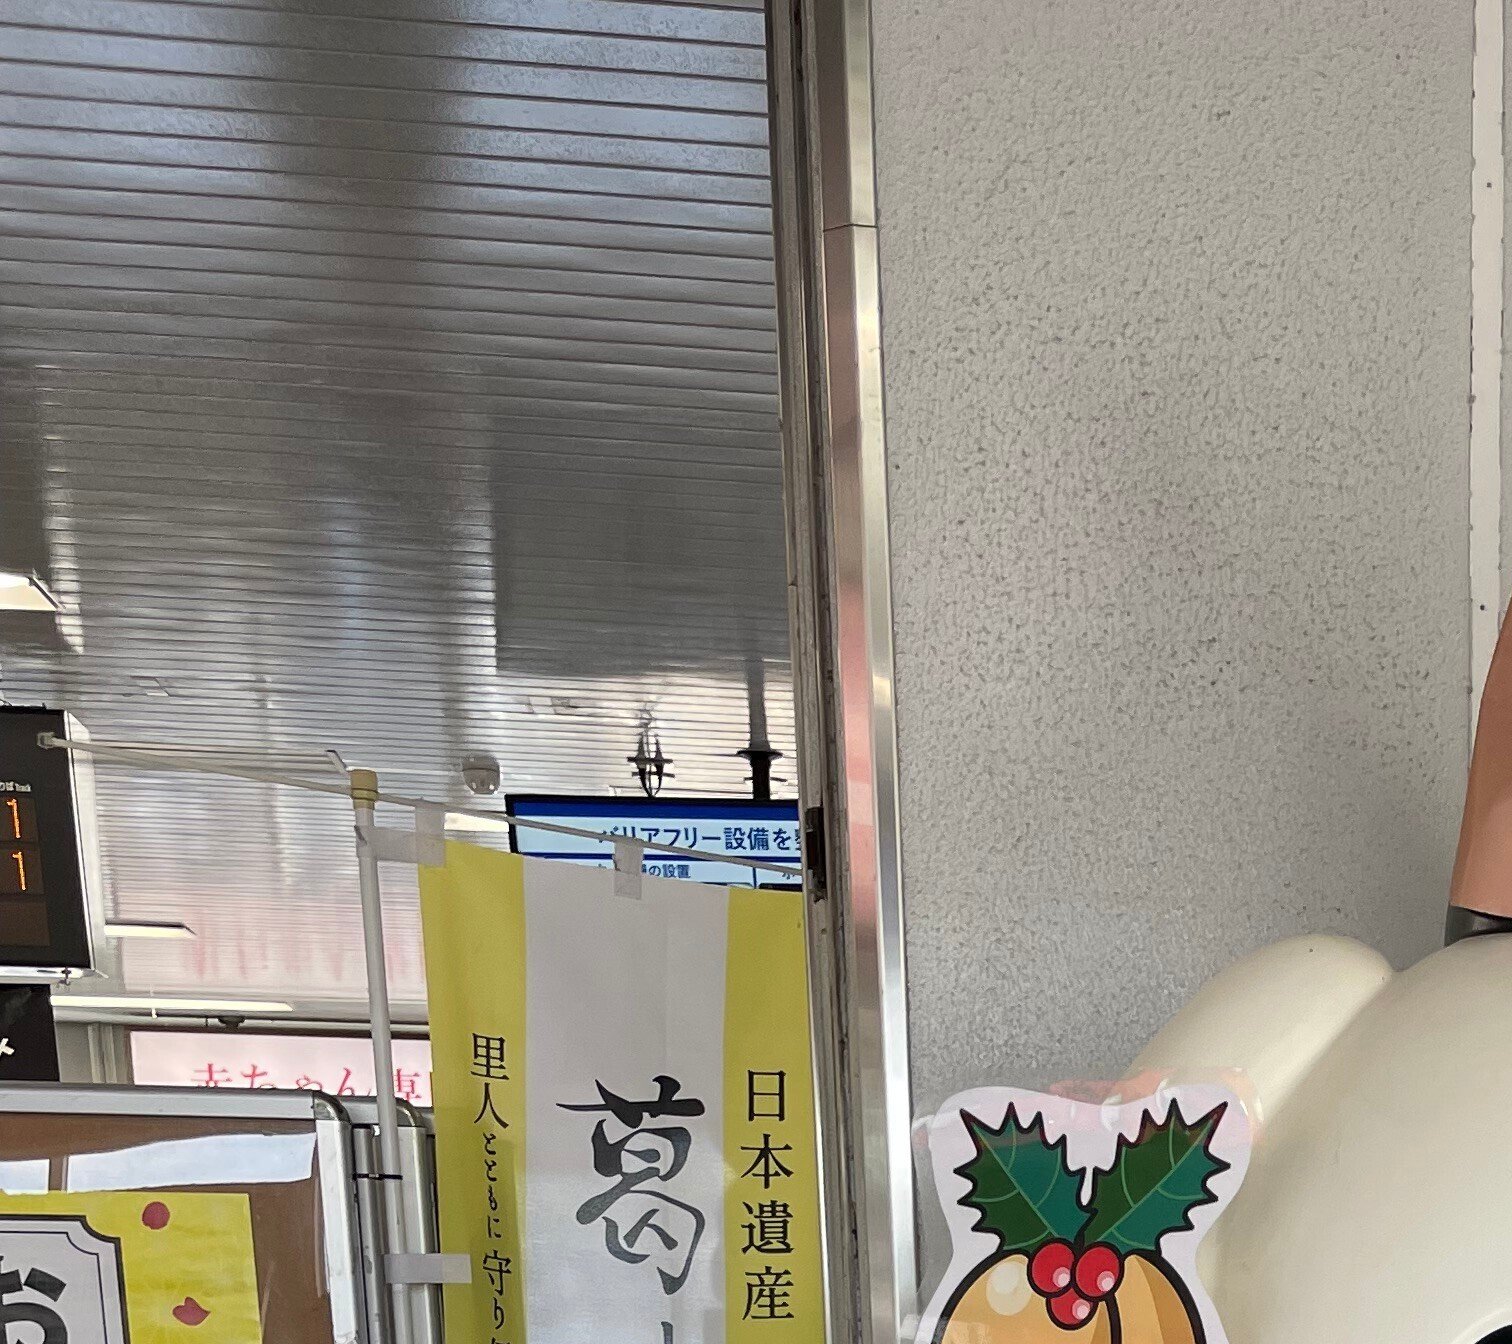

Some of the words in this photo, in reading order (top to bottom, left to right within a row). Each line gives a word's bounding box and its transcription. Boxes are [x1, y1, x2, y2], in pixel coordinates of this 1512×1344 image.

[7, 798, 20, 839] 1
[12, 851, 26, 891] 1
[740, 1069, 794, 1321] 日本遺産
